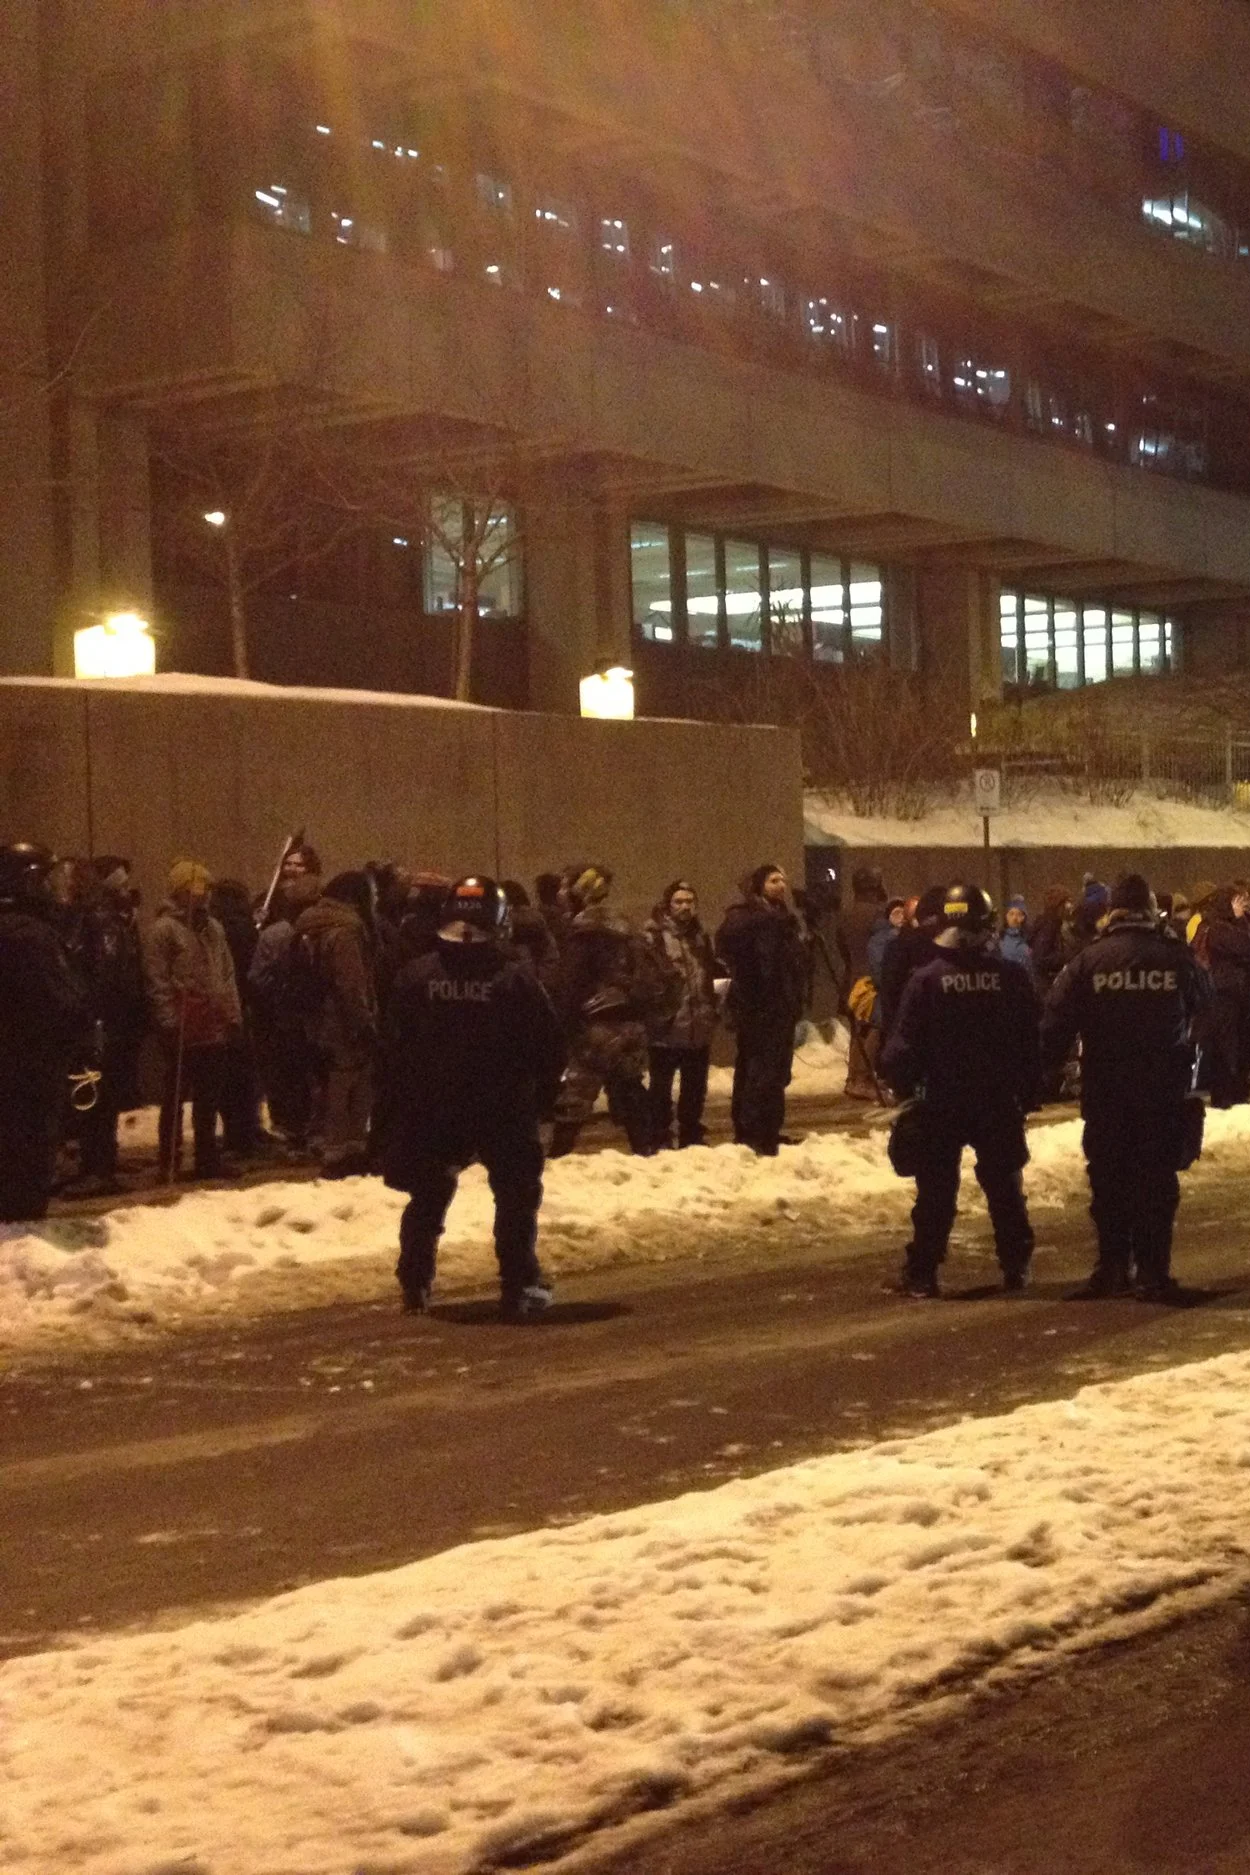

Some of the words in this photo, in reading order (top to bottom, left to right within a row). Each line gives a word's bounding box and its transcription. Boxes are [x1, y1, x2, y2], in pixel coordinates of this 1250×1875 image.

[428, 980, 492, 1000] POLICE
[940, 971, 1000, 992] POLICE
[1093, 970, 1178, 992] POLICE
